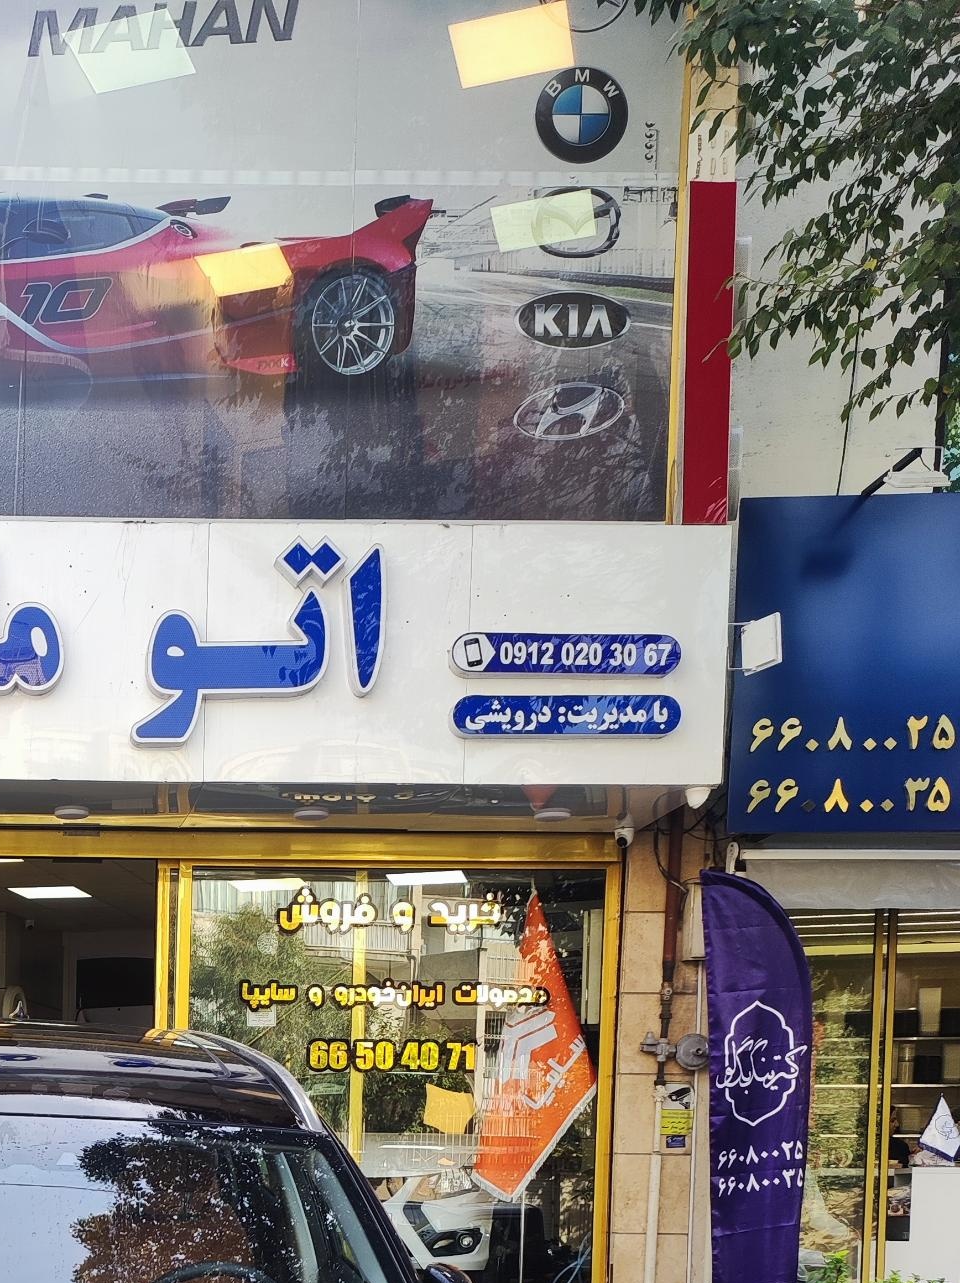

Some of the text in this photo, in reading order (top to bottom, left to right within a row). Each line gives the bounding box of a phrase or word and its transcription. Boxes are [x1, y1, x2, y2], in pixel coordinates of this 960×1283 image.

[28, 0, 295, 57] MAHAN
[545, 69, 619, 98] BMW
[20, 277, 113, 325] 10
[534, 304, 612, 337] KIA
[130, 535, 387, 747] اتو
[500, 642, 672, 666] 0912 020 30 67
[465, 700, 551, 731] درویشی
[653, 699, 668, 730] با
[278, 888, 501, 932] خرید و فروش
[241, 982, 296, 1009] سایپا
[308, 986, 323, 1006] و
[455, 984, 547, 1007] محصولات
[309, 1041, 475, 1070] 66 50 40 71
